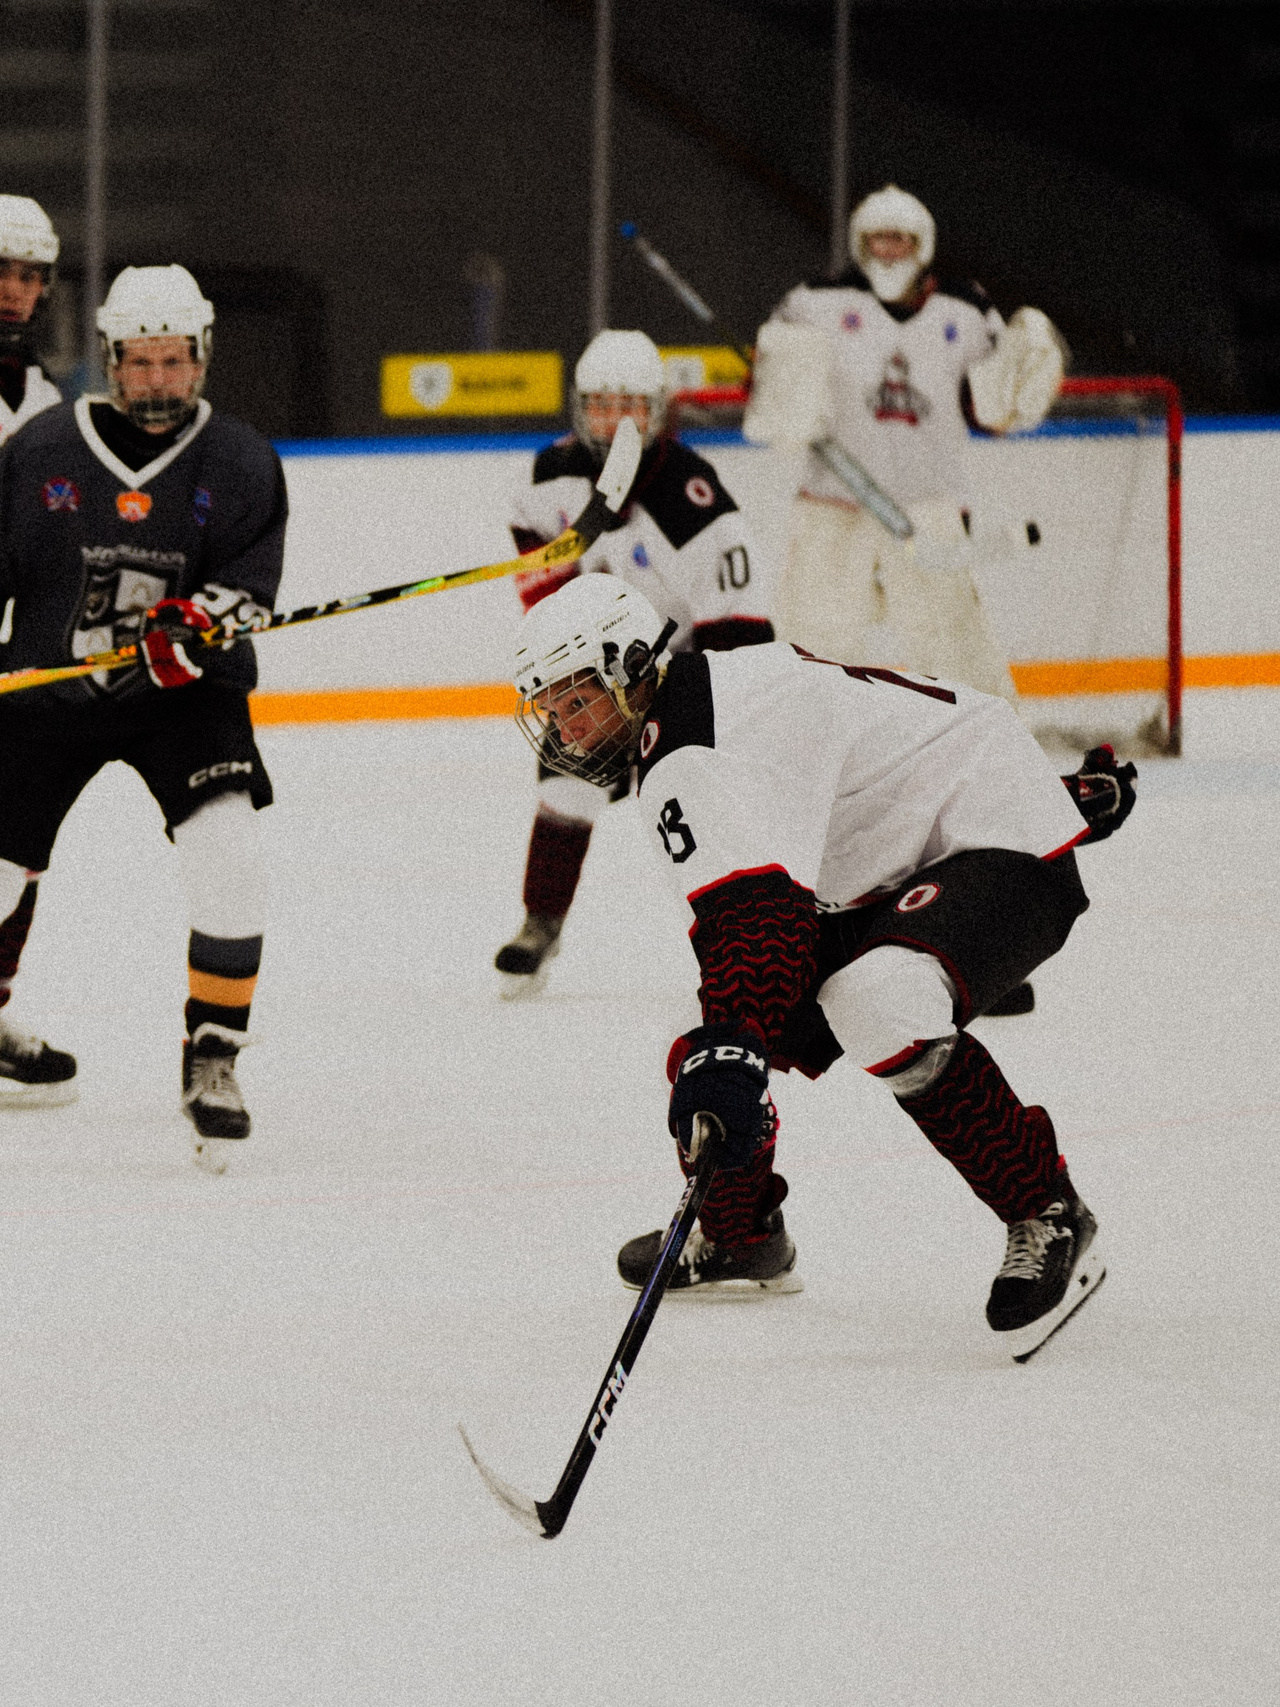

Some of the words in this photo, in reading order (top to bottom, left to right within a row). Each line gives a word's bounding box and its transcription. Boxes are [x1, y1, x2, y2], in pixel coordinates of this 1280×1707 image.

[188, 761, 253, 789] CCM
[682, 1045, 766, 1075] CCM
[587, 1360, 629, 1447] CCM
